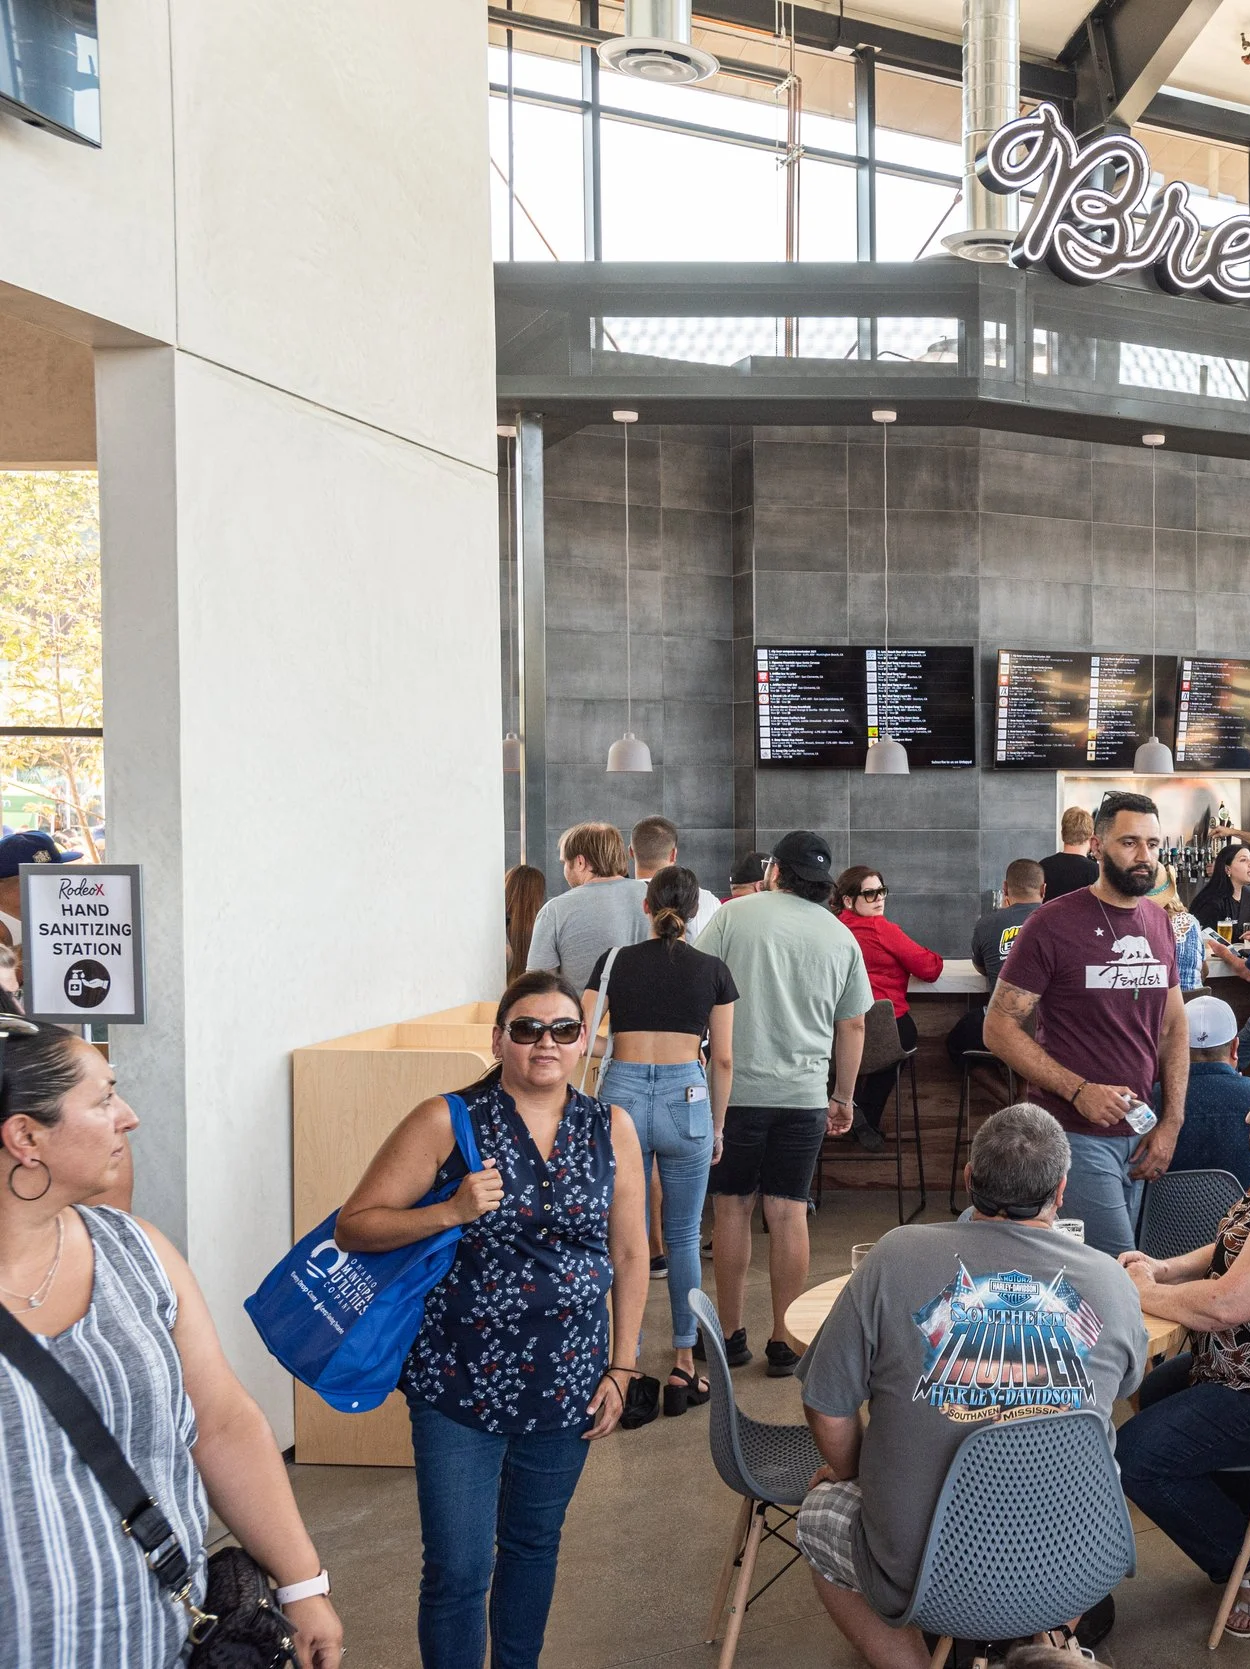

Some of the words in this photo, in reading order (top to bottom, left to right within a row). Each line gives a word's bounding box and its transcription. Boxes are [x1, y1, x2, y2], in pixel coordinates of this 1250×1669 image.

[61, 904, 110, 917] HAND
[39, 923, 132, 937] SANITIZING
[52, 942, 122, 956] STATION
[1098, 965, 1161, 989] Fender
[341, 1263, 374, 1304] MUNICIPA
[1003, 1275, 1028, 1283] MOTOR
[323, 1281, 351, 1313] COPANY
[950, 1302, 1068, 1326] SOUTHERN
[920, 1322, 1092, 1396] THUNDER
[930, 1385, 1083, 1409] HARLEY-DAVIDSON
[948, 1408, 1000, 1421] SOUTHAVEN
